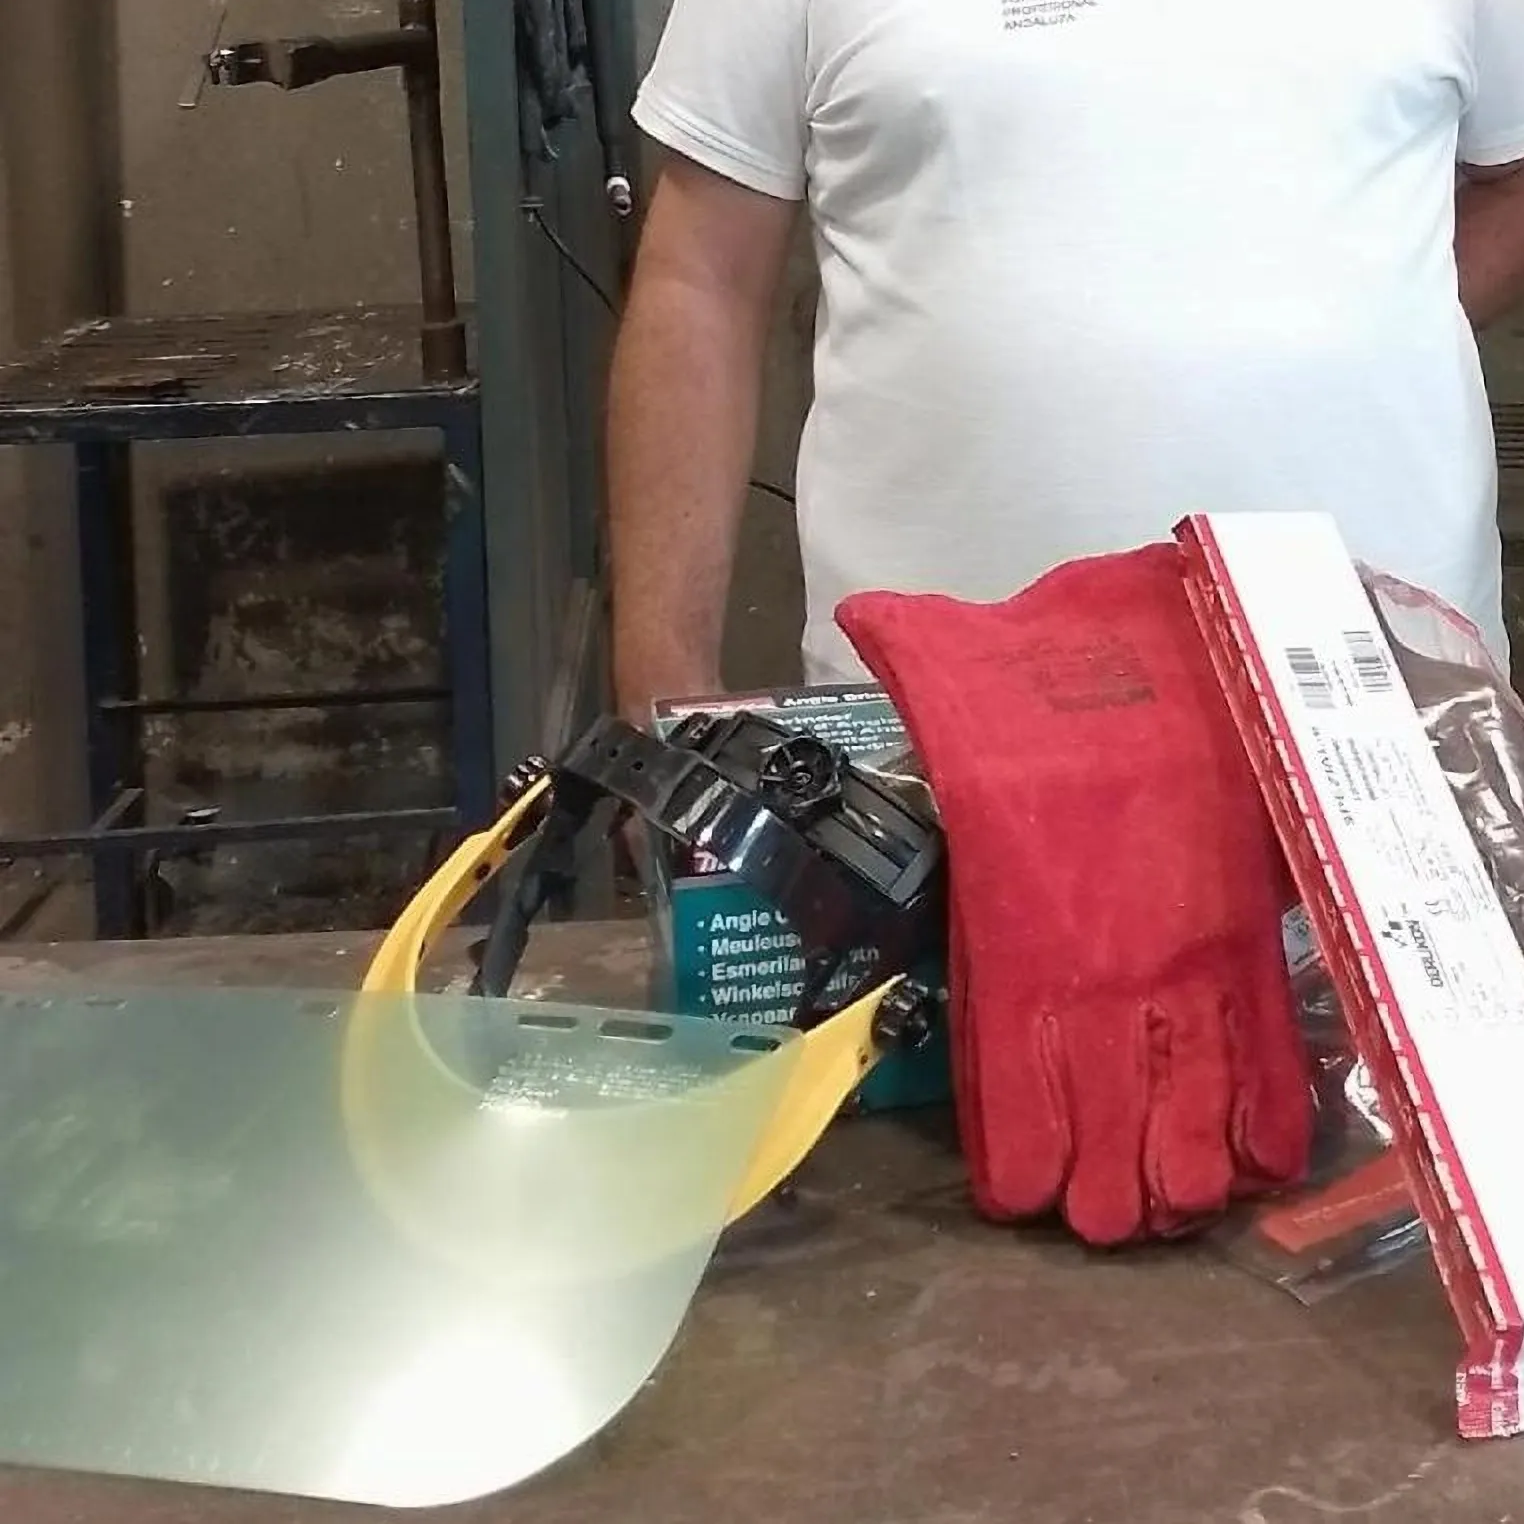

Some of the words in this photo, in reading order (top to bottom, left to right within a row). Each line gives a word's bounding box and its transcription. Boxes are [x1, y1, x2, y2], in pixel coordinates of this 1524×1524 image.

[710, 910, 771, 932] Angle
[711, 933, 802, 957] Meuleus
[711, 957, 806, 981] Esmerila
[712, 981, 805, 1007] Winkelsc
